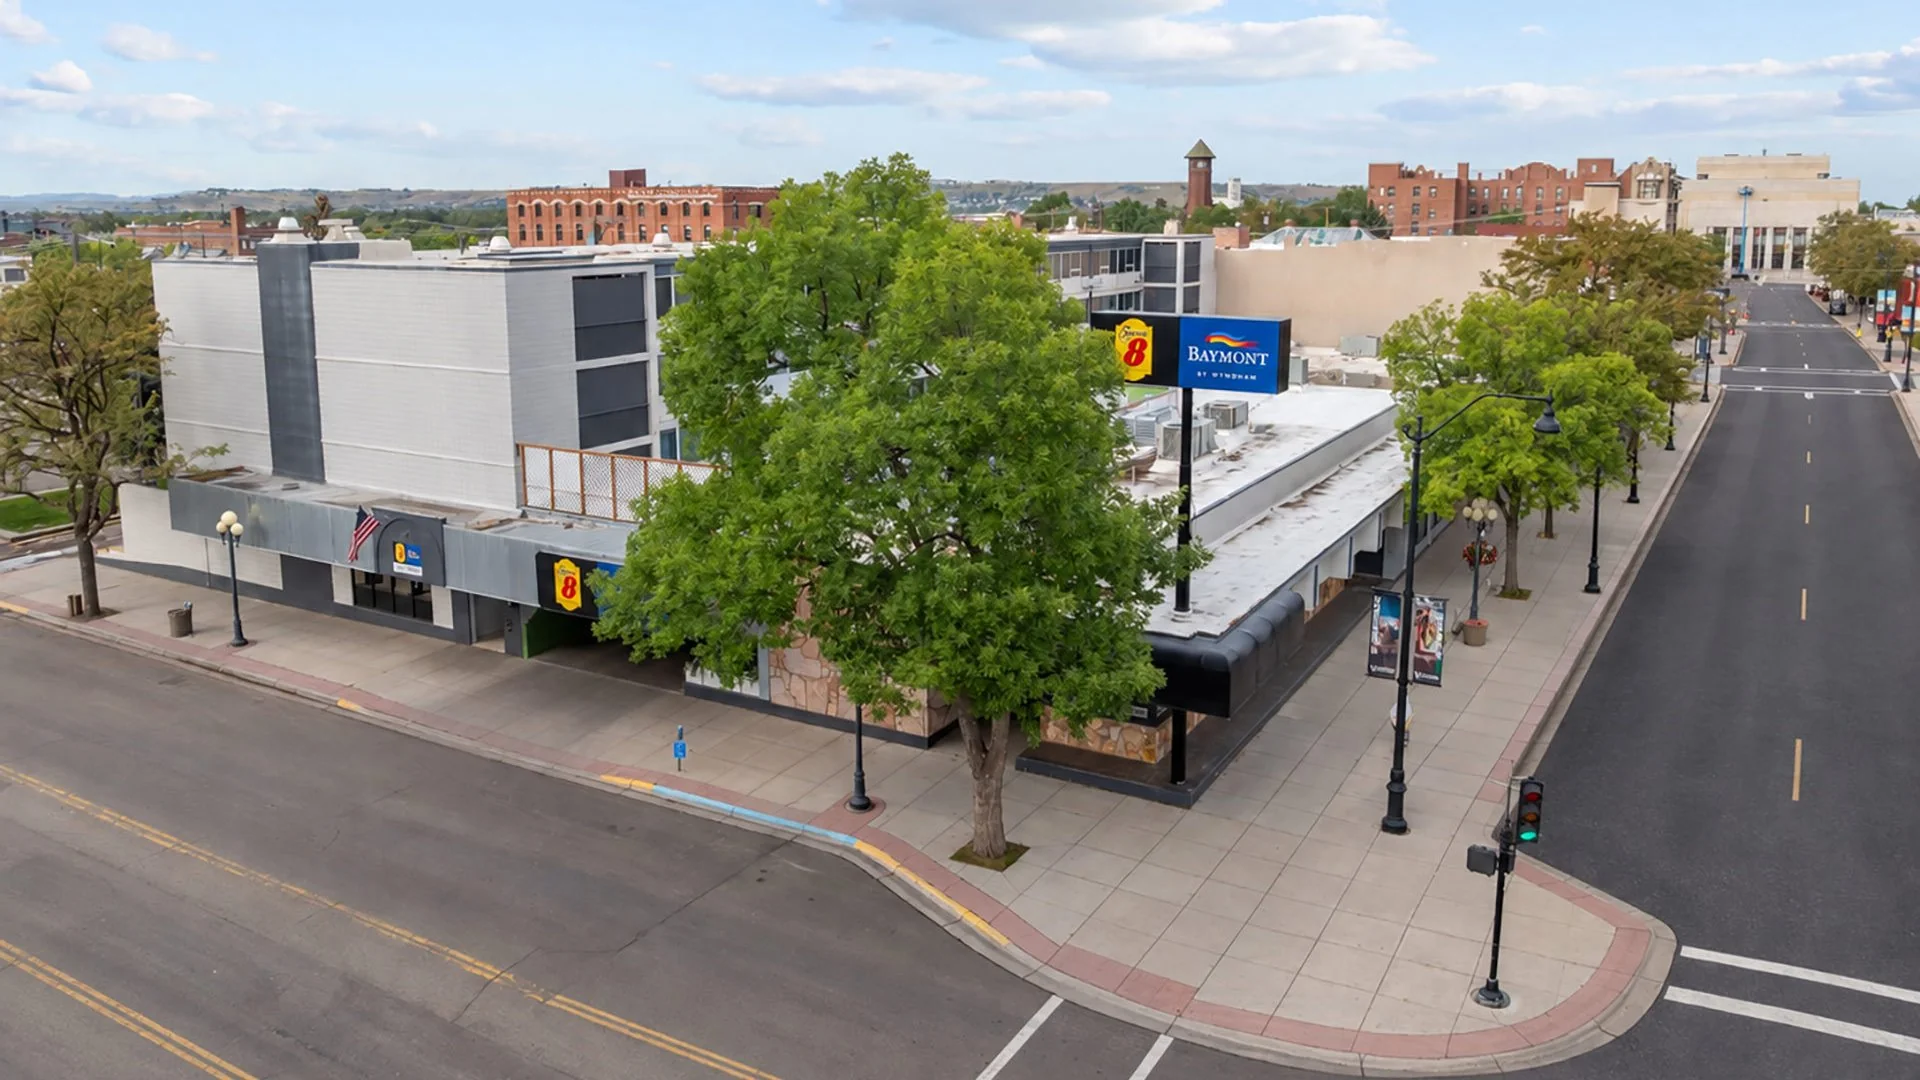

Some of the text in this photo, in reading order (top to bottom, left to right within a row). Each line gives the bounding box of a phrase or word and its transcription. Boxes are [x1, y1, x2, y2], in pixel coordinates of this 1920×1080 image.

[1123, 337, 1148, 366] 8
[1188, 345, 1269, 366] BAYMONT
[561, 575, 577, 599] 8
